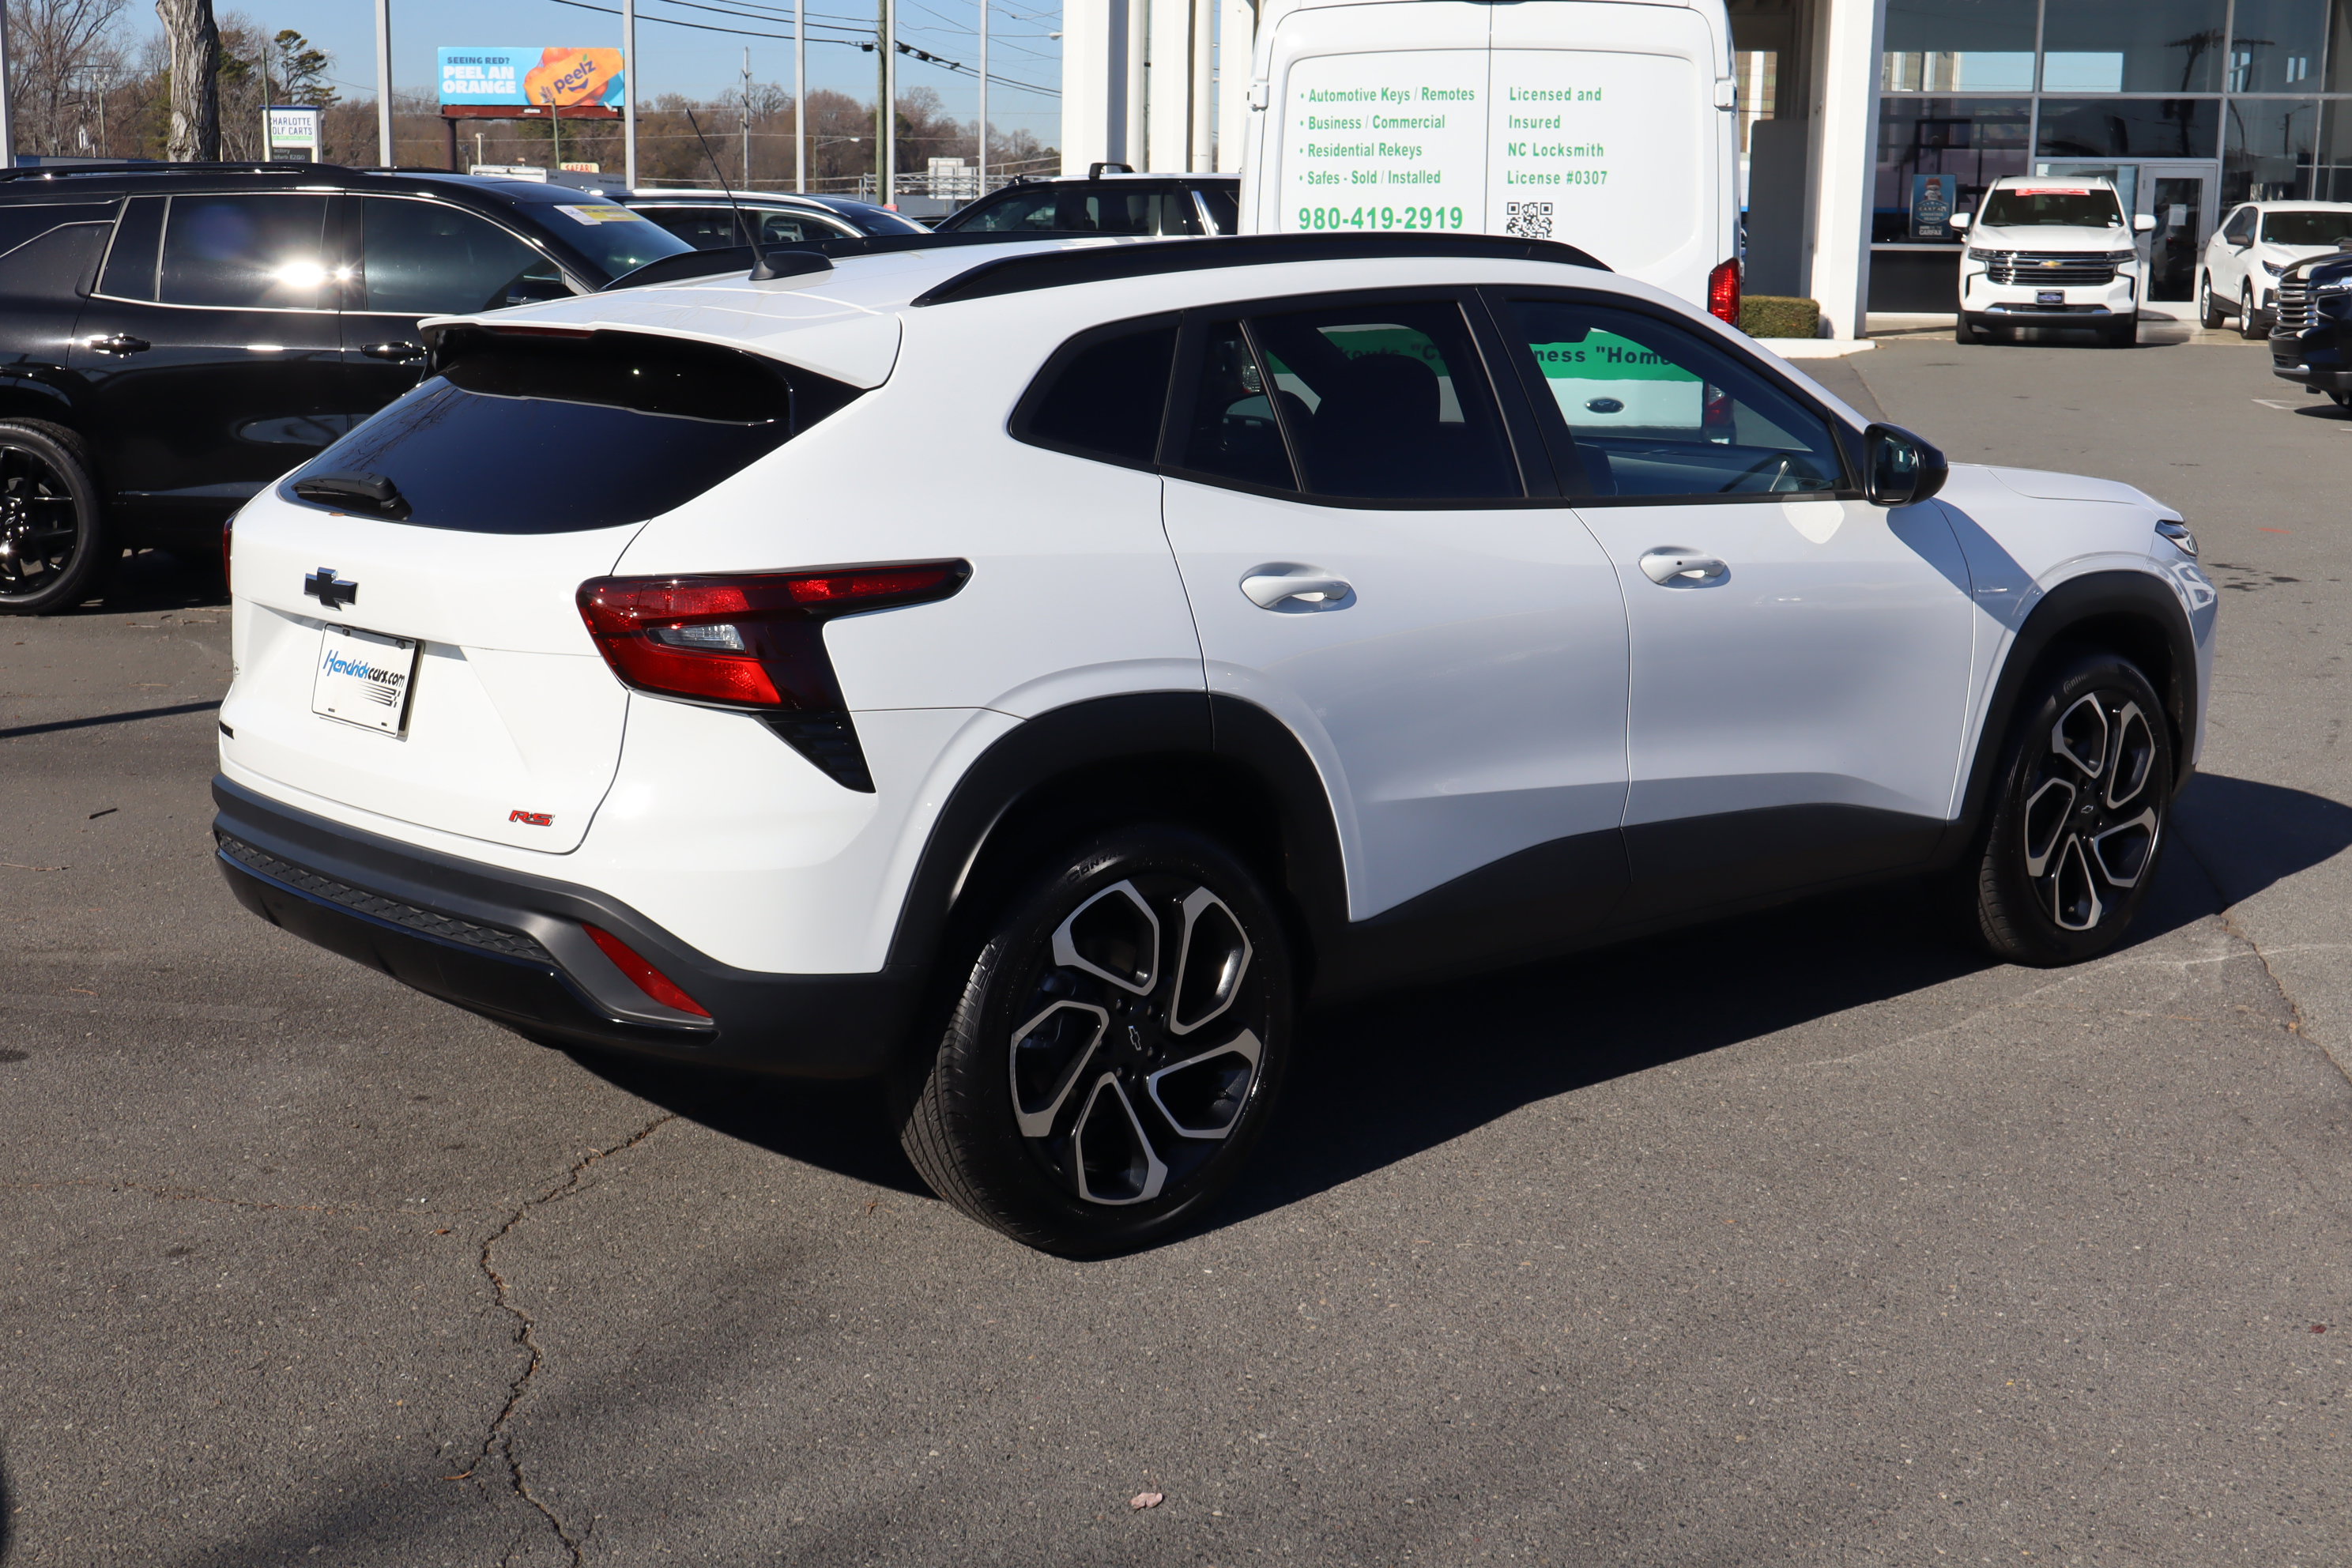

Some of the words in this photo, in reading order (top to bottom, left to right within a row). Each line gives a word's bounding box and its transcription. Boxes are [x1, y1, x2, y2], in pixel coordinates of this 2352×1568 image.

[443, 66, 485, 79] PEEL
[488, 66, 514, 79] AN
[553, 60, 596, 94] peelz
[442, 81, 516, 93] ORANGE
[1510, 87, 1572, 102] Licensed
[1577, 87, 1603, 102] and
[1309, 88, 1377, 102] Automotive
[1381, 88, 1411, 104] Keys
[1422, 87, 1476, 101] Remotes
[270, 117, 311, 126] HARLOTTE
[1308, 115, 1362, 130] Business
[1373, 115, 1446, 129] Commercial
[1509, 115, 1562, 129] Insured
[272, 126, 285, 135] OLF
[288, 126, 313, 135] CARTS
[1308, 143, 1374, 157] Residential
[1378, 142, 1423, 160] Rekeys
[1508, 142, 1527, 157] NC
[1532, 142, 1604, 157] Locksmith
[565, 164, 593, 172] SAFARI
[1307, 171, 1341, 185] Safes
[1351, 170, 1378, 185] Sold
[1388, 170, 1442, 184] Installed
[1507, 170, 1561, 185] License
[1566, 170, 1608, 185] #0307
[1298, 206, 1463, 230] 980-419-2919
[1534, 349, 1586, 363] ness
[508, 809, 555, 827] RS
